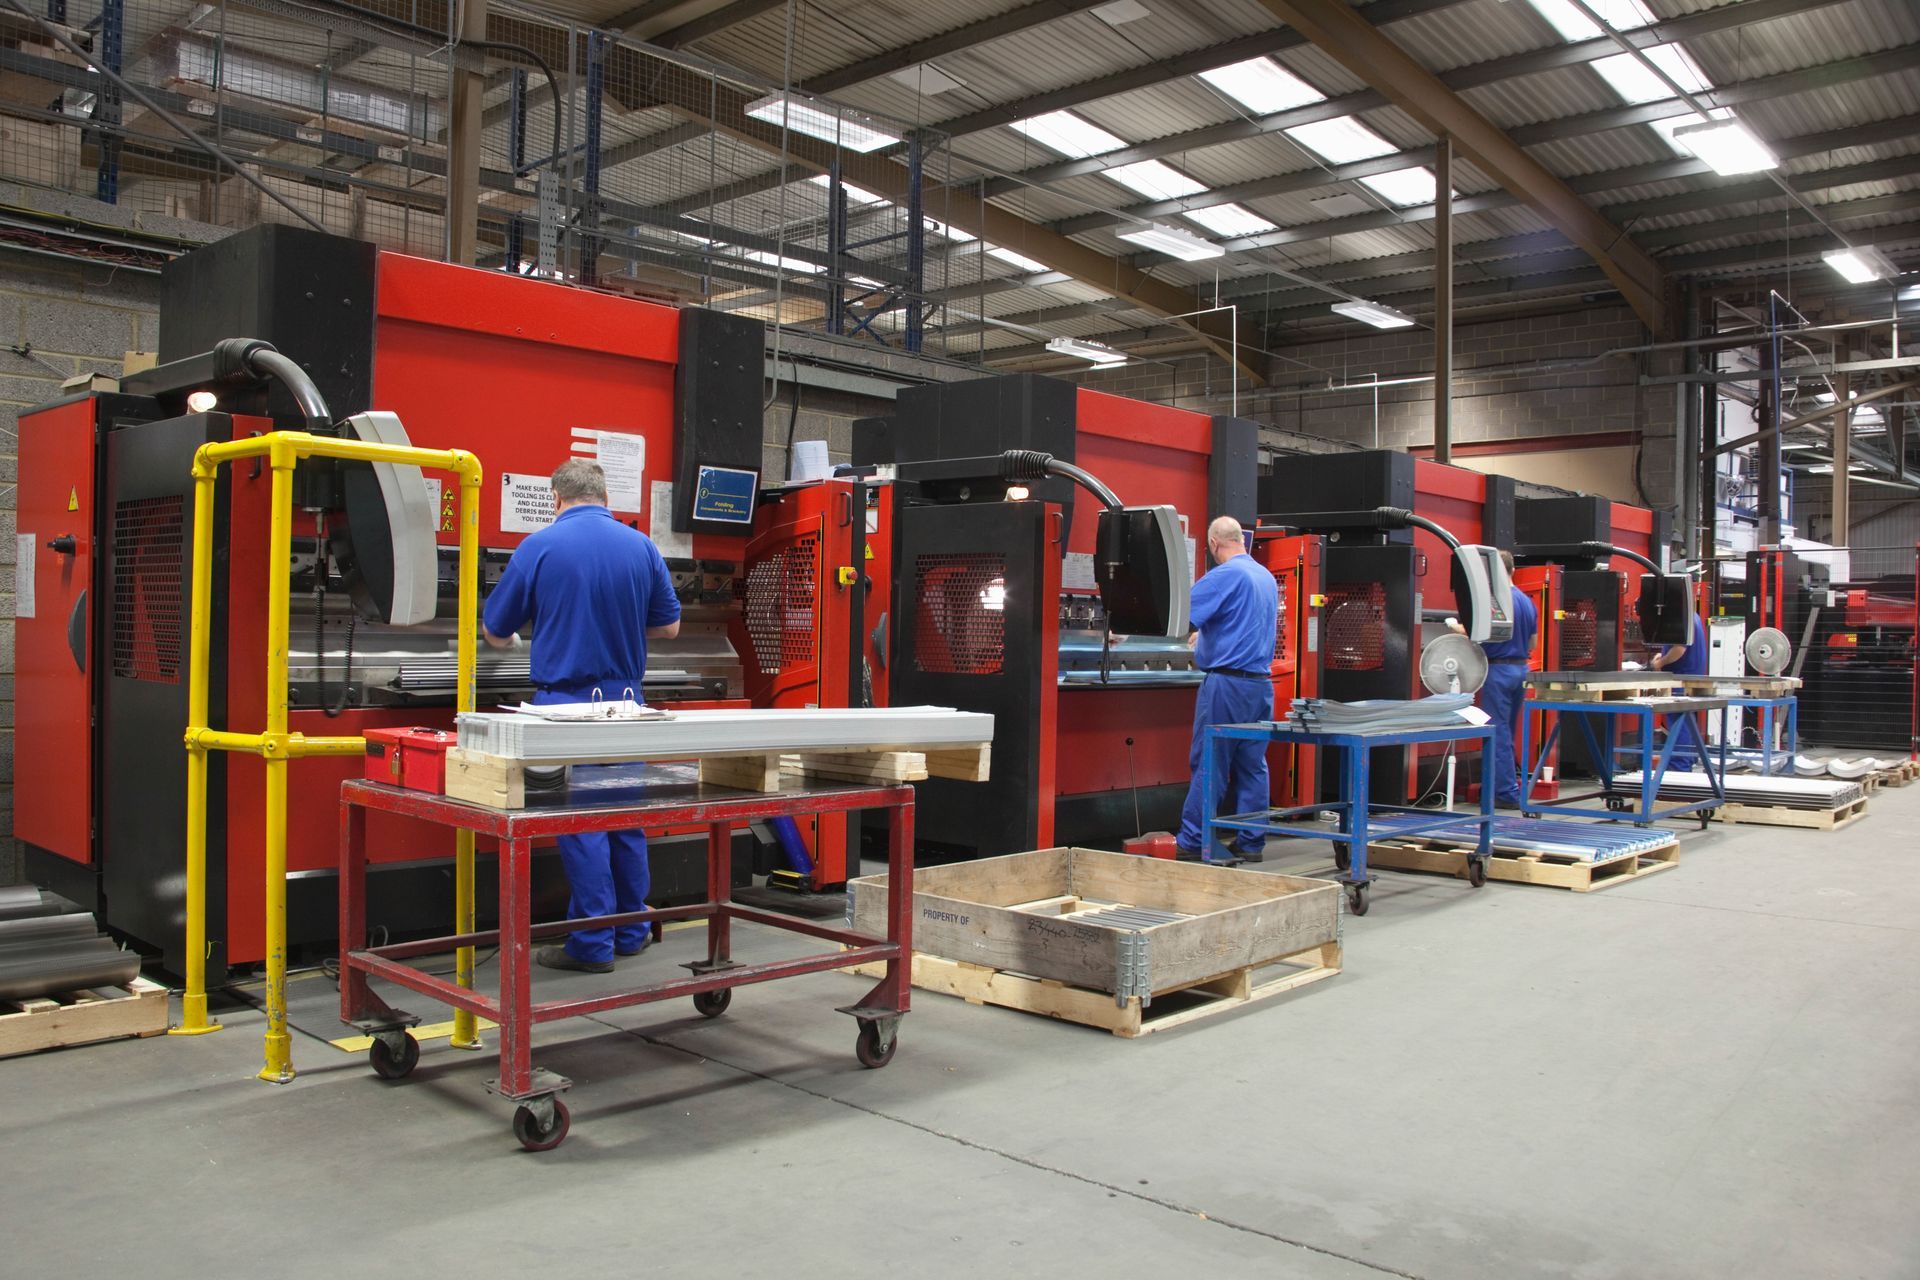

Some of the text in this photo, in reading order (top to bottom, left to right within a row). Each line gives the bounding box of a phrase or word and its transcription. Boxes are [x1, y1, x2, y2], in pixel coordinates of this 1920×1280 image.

[516, 484, 533, 492] MAKE
[512, 491, 538, 500] TOOLING
[531, 501, 549, 509] CLEAR
[714, 501, 735, 509] Folding
[515, 507, 537, 515] DEBRIS
[923, 908, 970, 926] PROPERTY OF
